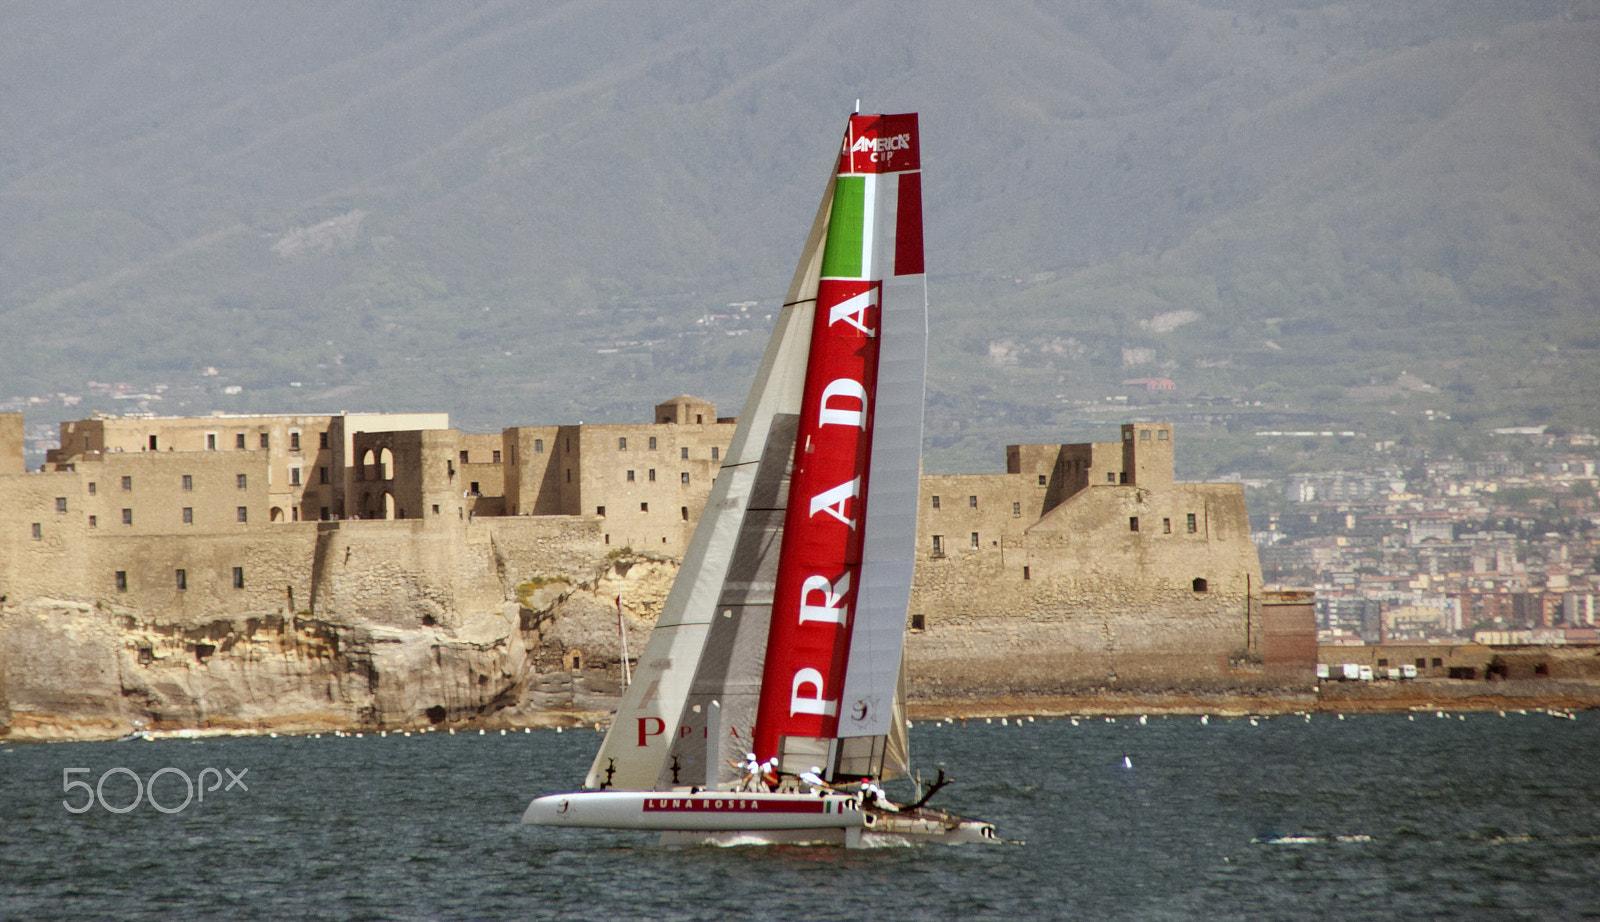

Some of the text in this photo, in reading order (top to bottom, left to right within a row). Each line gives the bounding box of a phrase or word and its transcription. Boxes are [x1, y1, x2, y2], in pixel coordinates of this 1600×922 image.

[851, 133, 910, 152] AMERICA'S
[870, 151, 893, 163] CUP
[789, 286, 879, 718] PRADA
[648, 799, 759, 810] LUNA ROSSA
